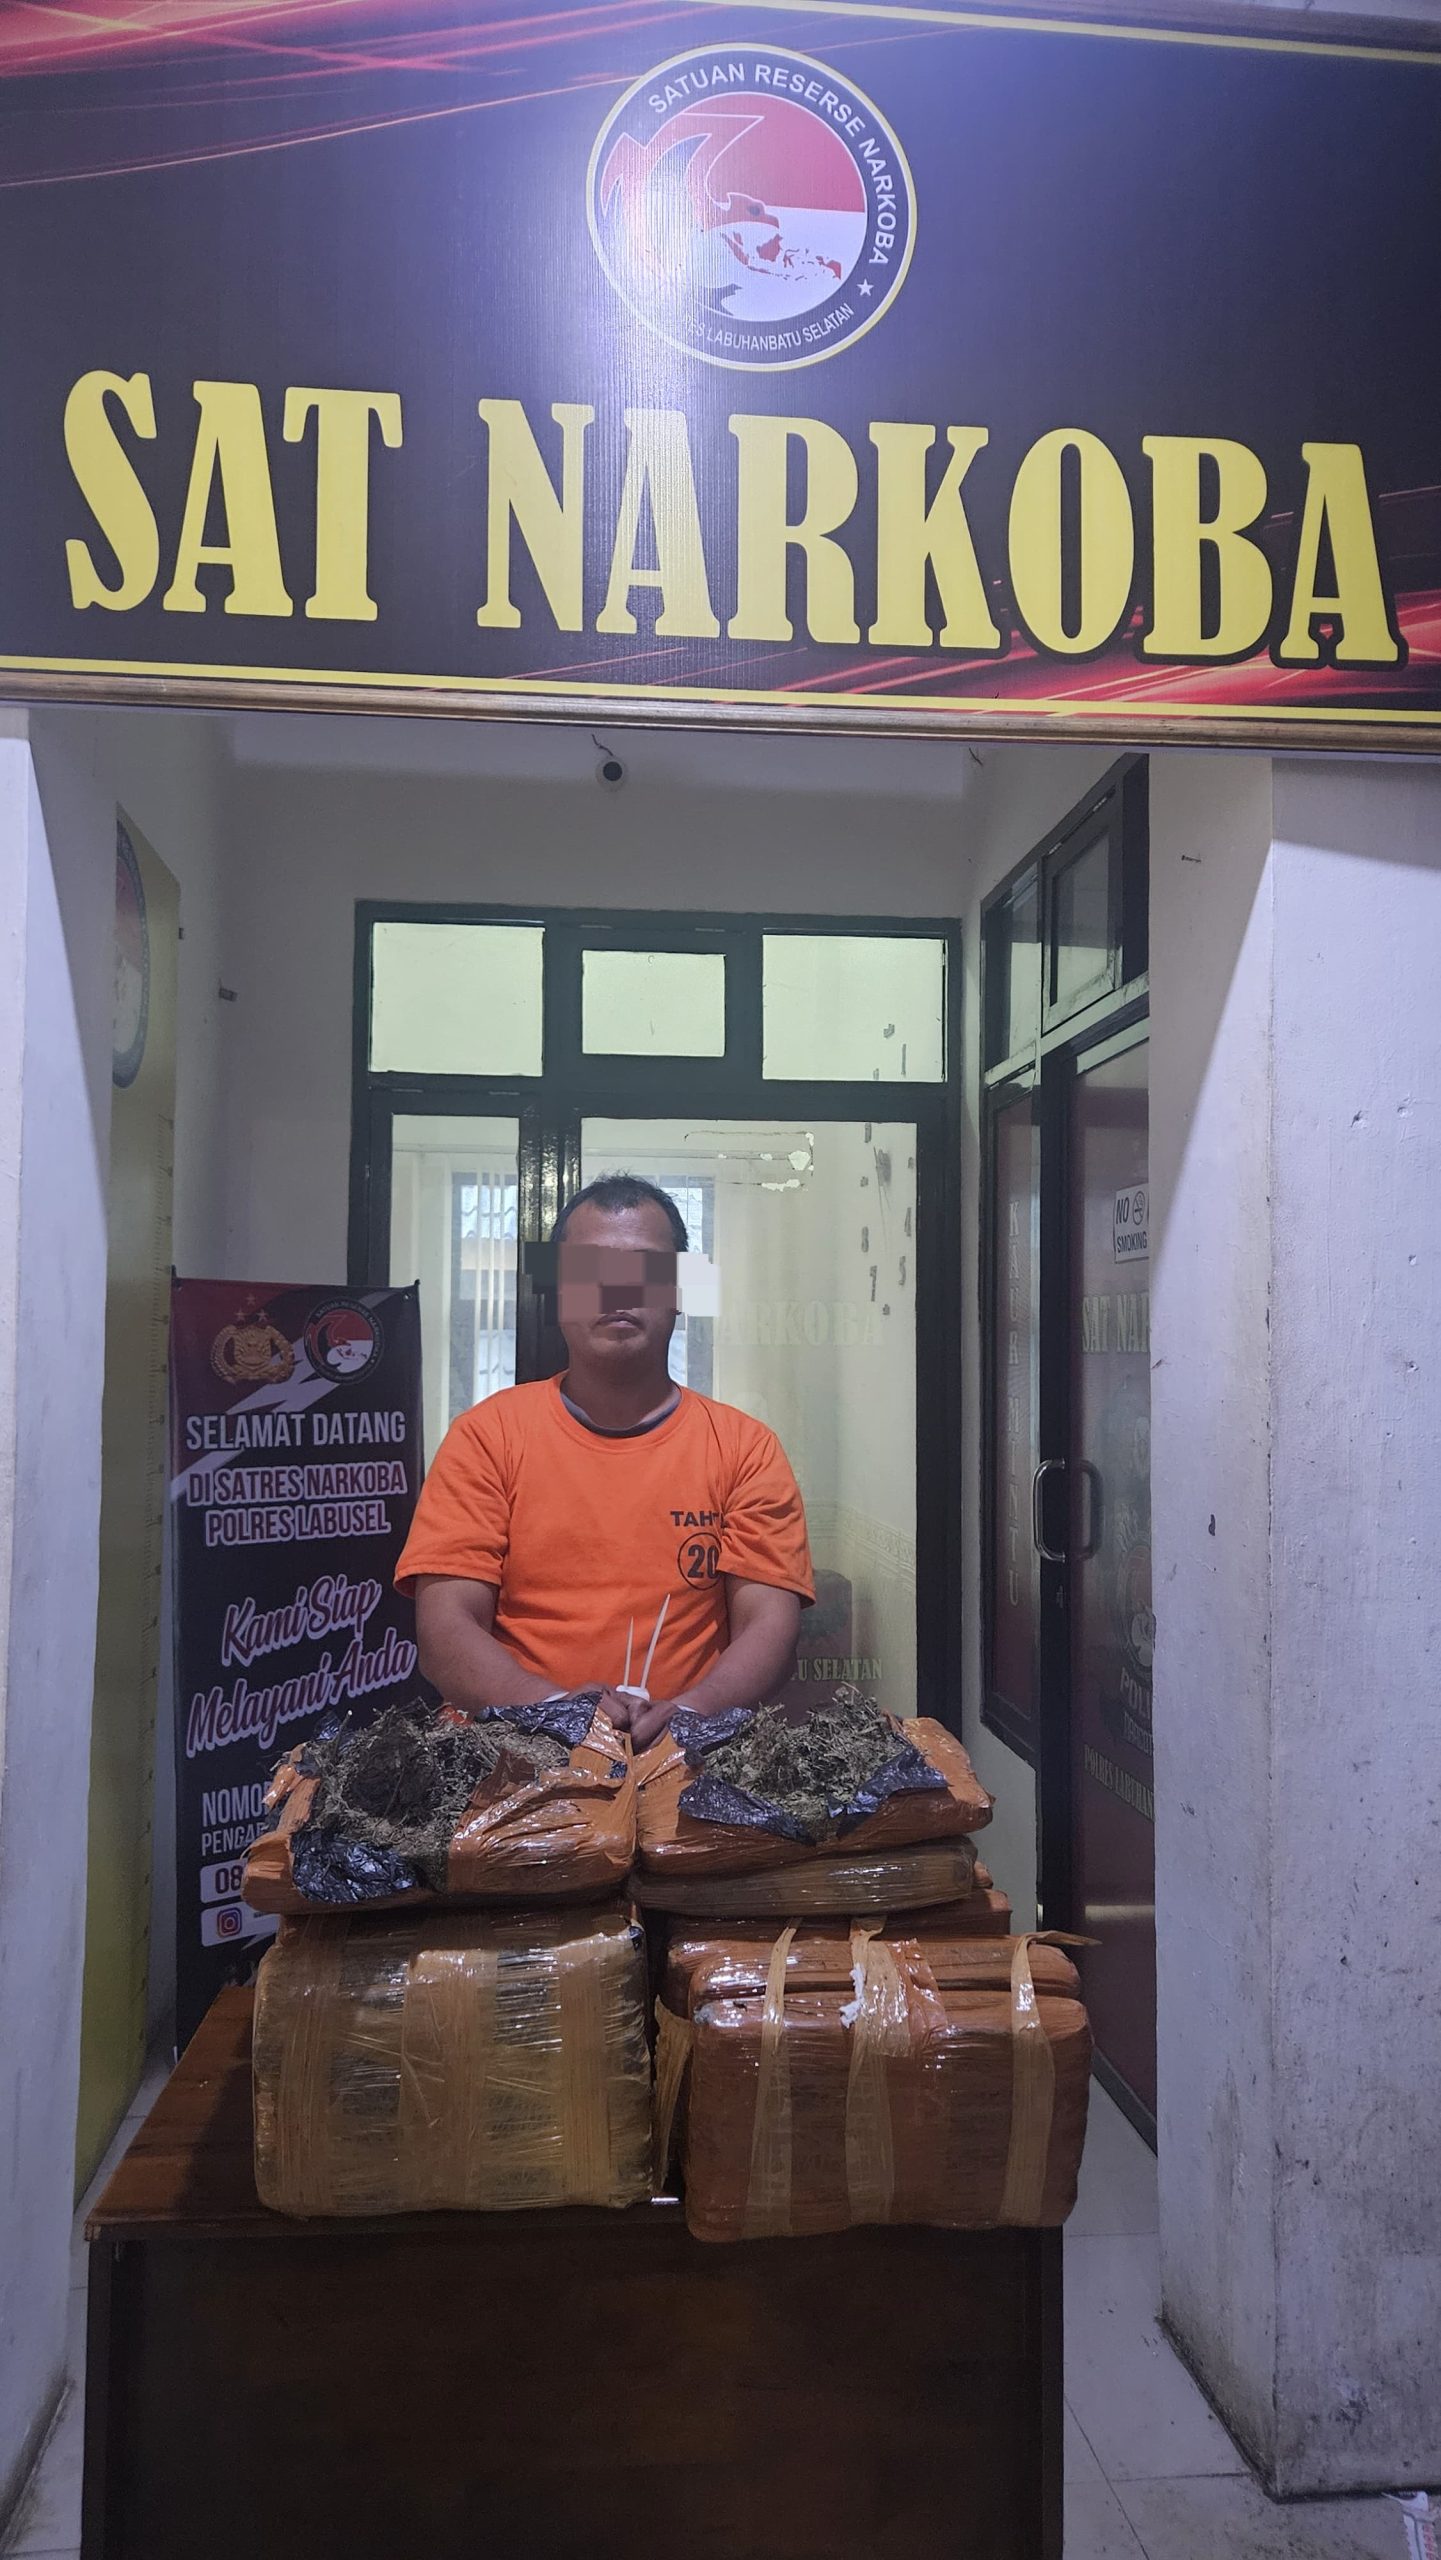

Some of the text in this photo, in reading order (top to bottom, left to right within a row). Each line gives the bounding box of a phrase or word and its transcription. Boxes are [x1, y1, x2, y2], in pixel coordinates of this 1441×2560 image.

[648, 63, 898, 265] SATUAN RESERSE NARKOBA
[706, 326, 802, 351] LABUHANBATU
[802, 302, 854, 342] SELATAN
[64, 370, 1399, 662] SAT NARKOBA
[1116, 1197, 1130, 1225] NO
[1117, 1231, 1148, 1253] SMOKING
[1082, 1296, 1110, 1352] SAT
[186, 1411, 406, 1450] SELAMAT DATANG
[188, 1460, 407, 1507] DI SATRES NARKOBA
[206, 1500, 390, 1546] POLRES LABUSEL
[687, 1544, 720, 1579] 20
[222, 1574, 382, 1667] Kami Siap
[187, 1627, 417, 1758] Melayani Anda
[813, 1658, 882, 1680] SELATAN
